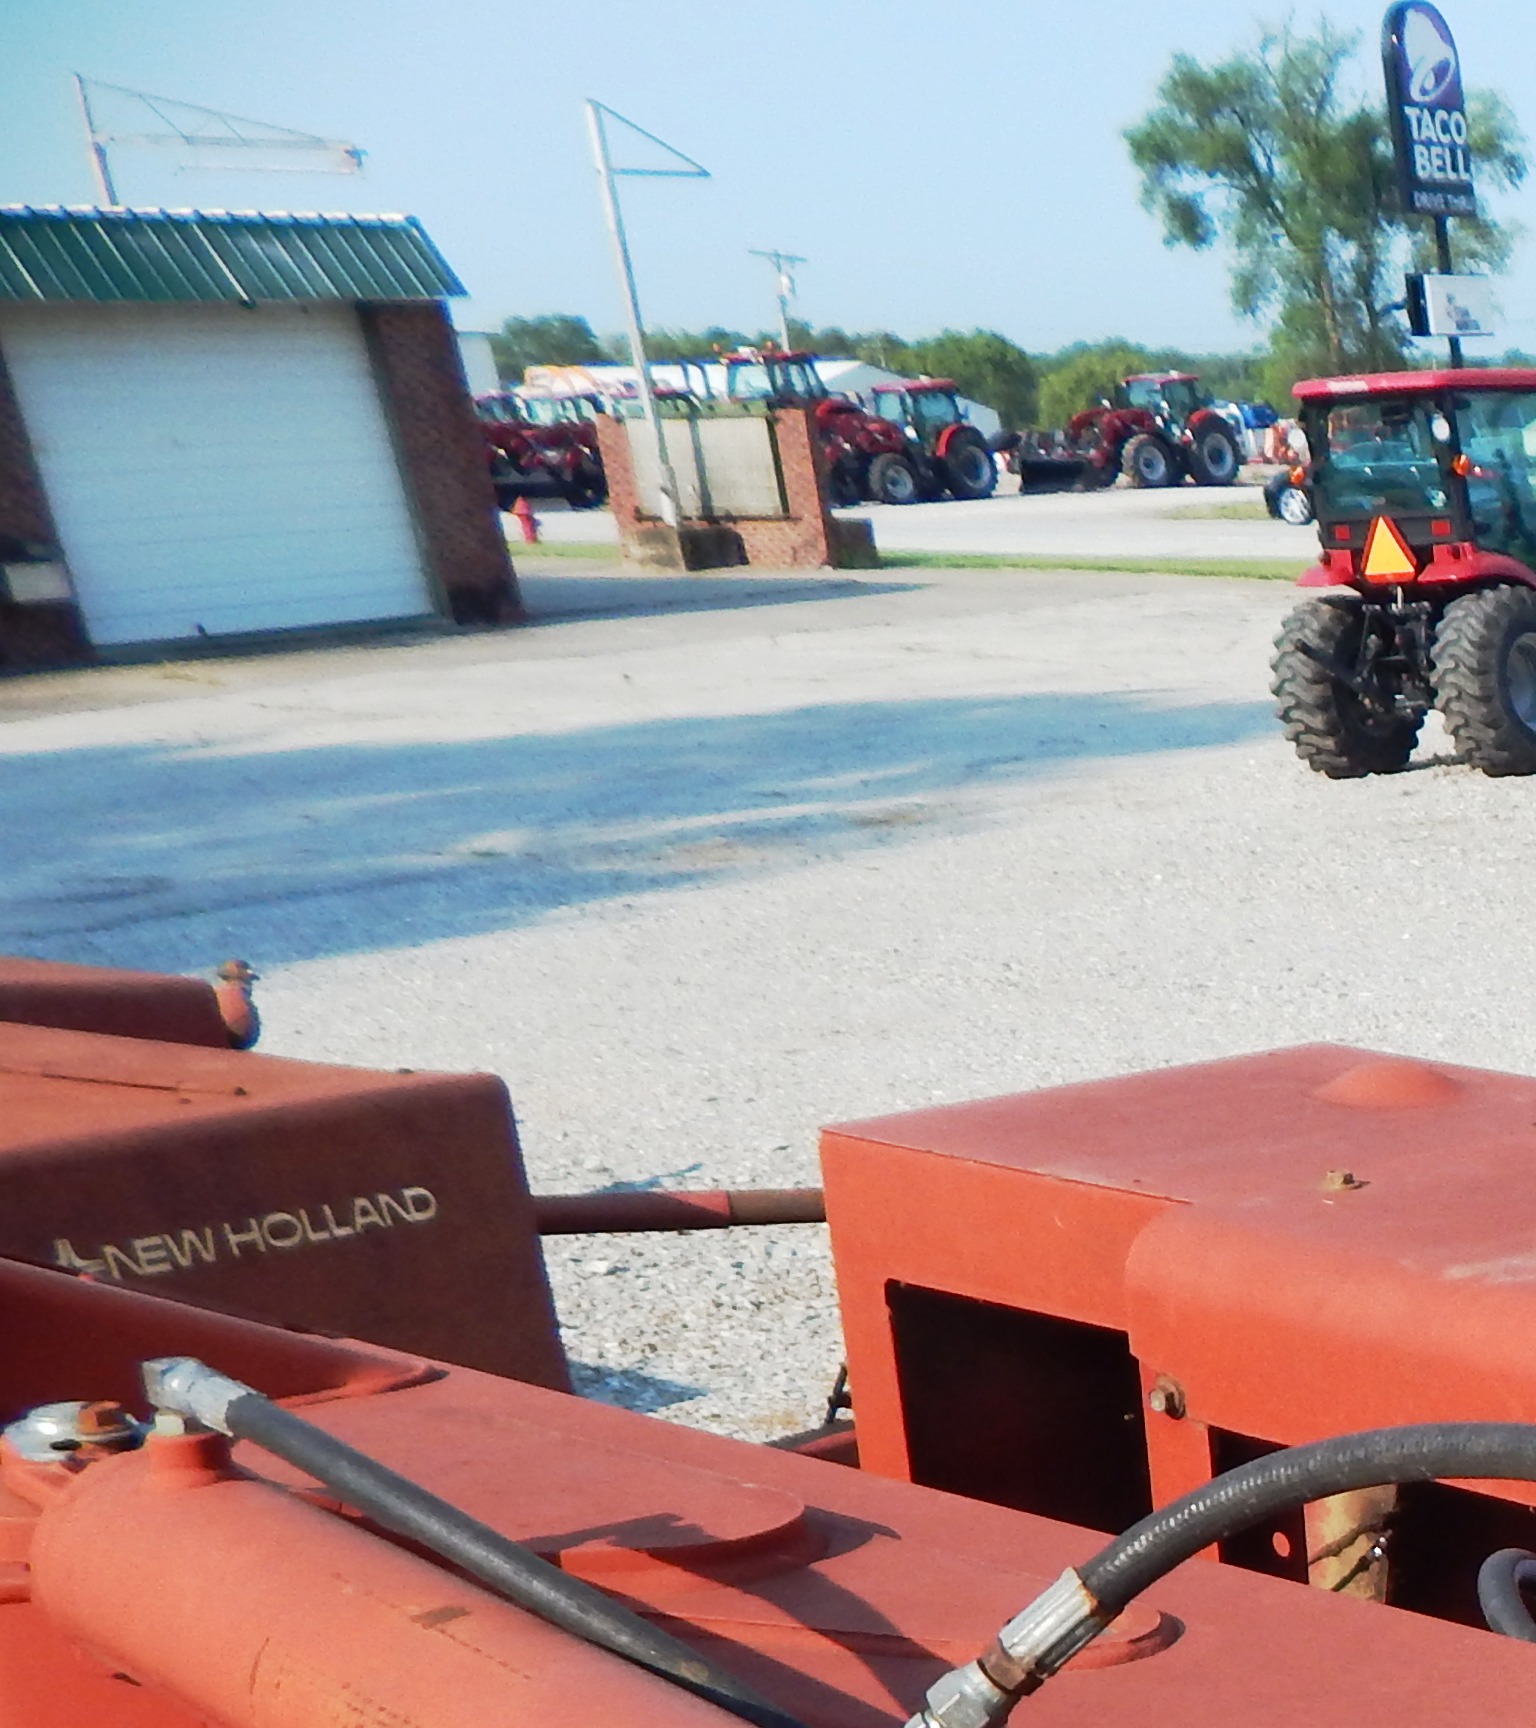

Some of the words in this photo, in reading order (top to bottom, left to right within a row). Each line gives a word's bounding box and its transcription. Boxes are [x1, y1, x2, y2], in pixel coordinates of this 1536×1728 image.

[1404, 106, 1467, 144] TACO
[1414, 144, 1472, 181] BELL
[101, 1226, 217, 1280] NEW
[222, 1186, 440, 1258] HOLLAND
